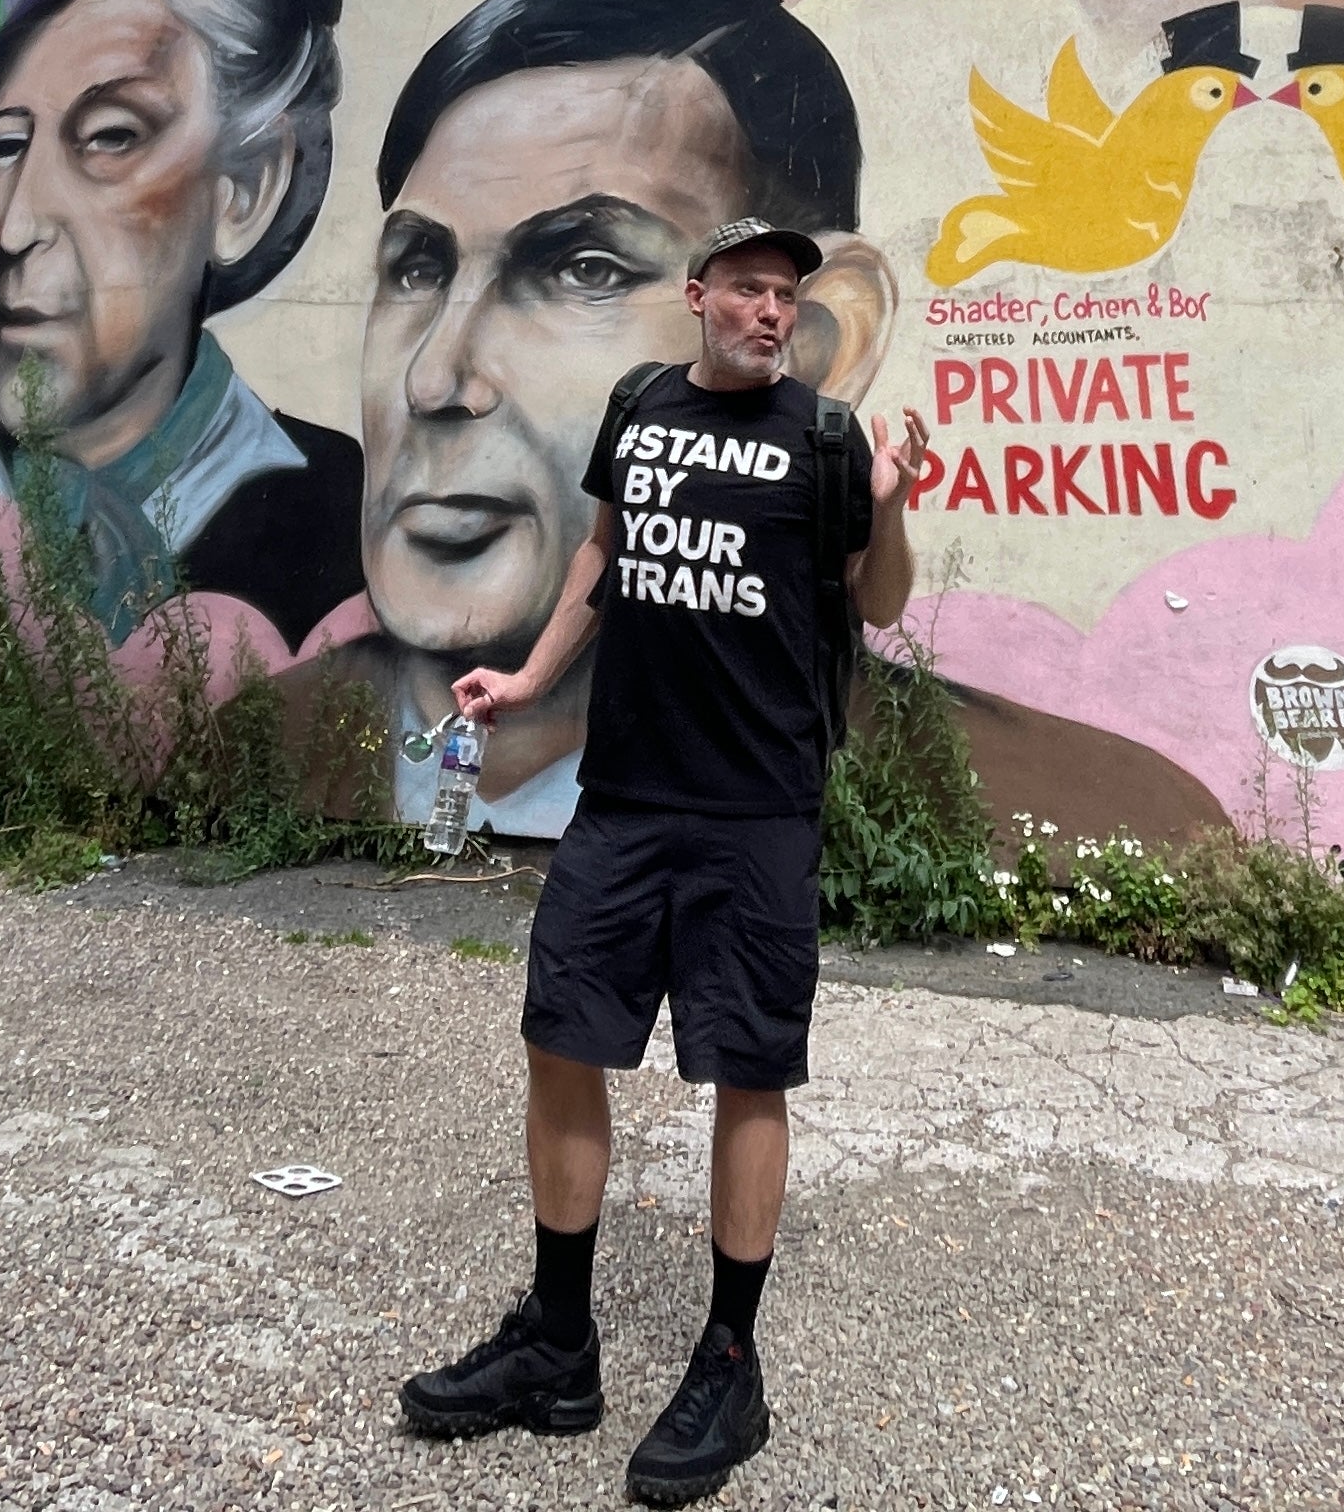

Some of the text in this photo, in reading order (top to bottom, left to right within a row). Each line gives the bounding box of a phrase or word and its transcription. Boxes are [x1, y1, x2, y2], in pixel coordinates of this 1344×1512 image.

[1053, 291, 1141, 322] Cohen
[1147, 282, 1164, 319] &
[946, 325, 1141, 346] CHARTERED ACCOUNTANTS.
[934, 351, 1196, 426] PRIVATE
[615, 424, 791, 482] #STAND
[907, 439, 1238, 521] PARKING
[623, 464, 689, 509] BY
[621, 509, 747, 568] YOUR
[616, 556, 767, 619] TRANS
